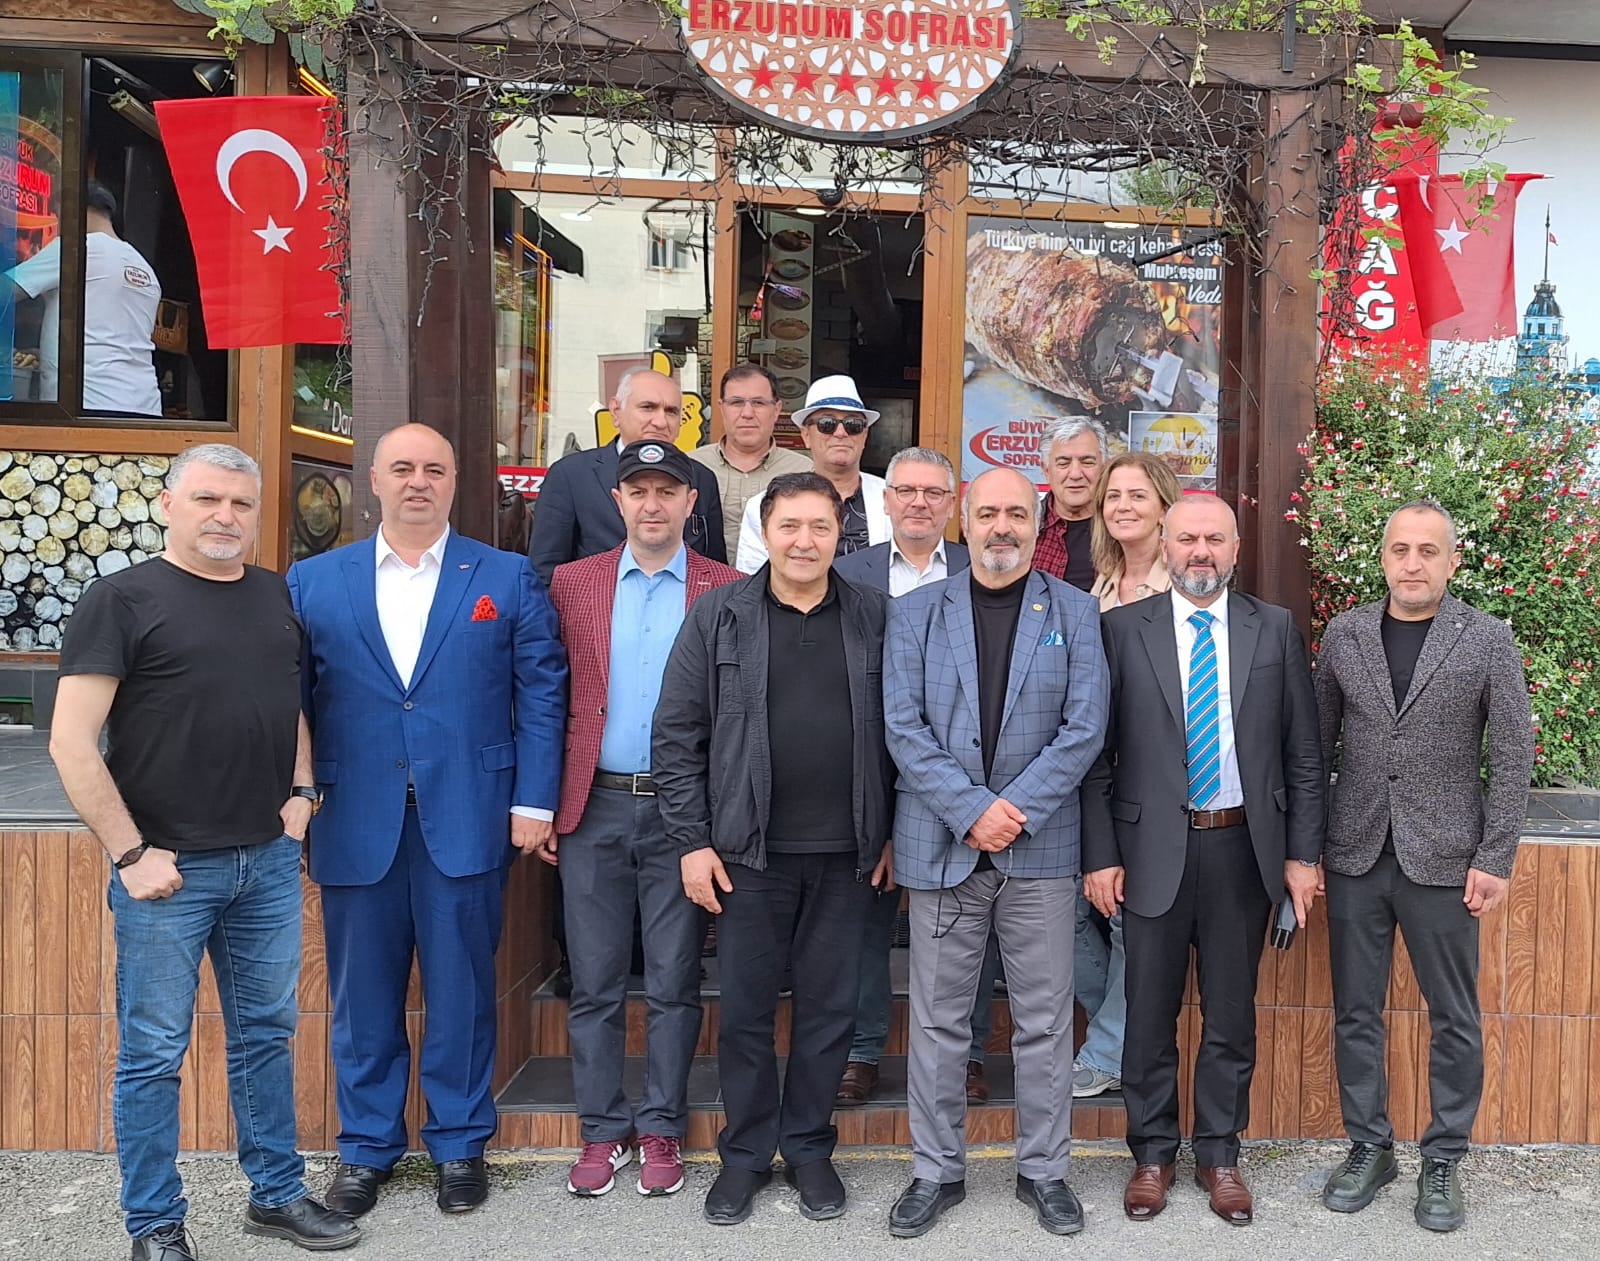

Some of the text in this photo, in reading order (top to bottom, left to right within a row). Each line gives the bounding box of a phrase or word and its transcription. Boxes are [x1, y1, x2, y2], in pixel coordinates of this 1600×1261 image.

[689, 0, 1006, 50] ERZURUM SOFRASI
[0, 183, 38, 214] OFRASI
[1110, 236, 1136, 258] cağ
[1009, 419, 1049, 434] BÜYÜ
[987, 435, 1041, 452] ERZU
[1003, 453, 1042, 466] SOFR
[498, 474, 545, 493] EZZ
